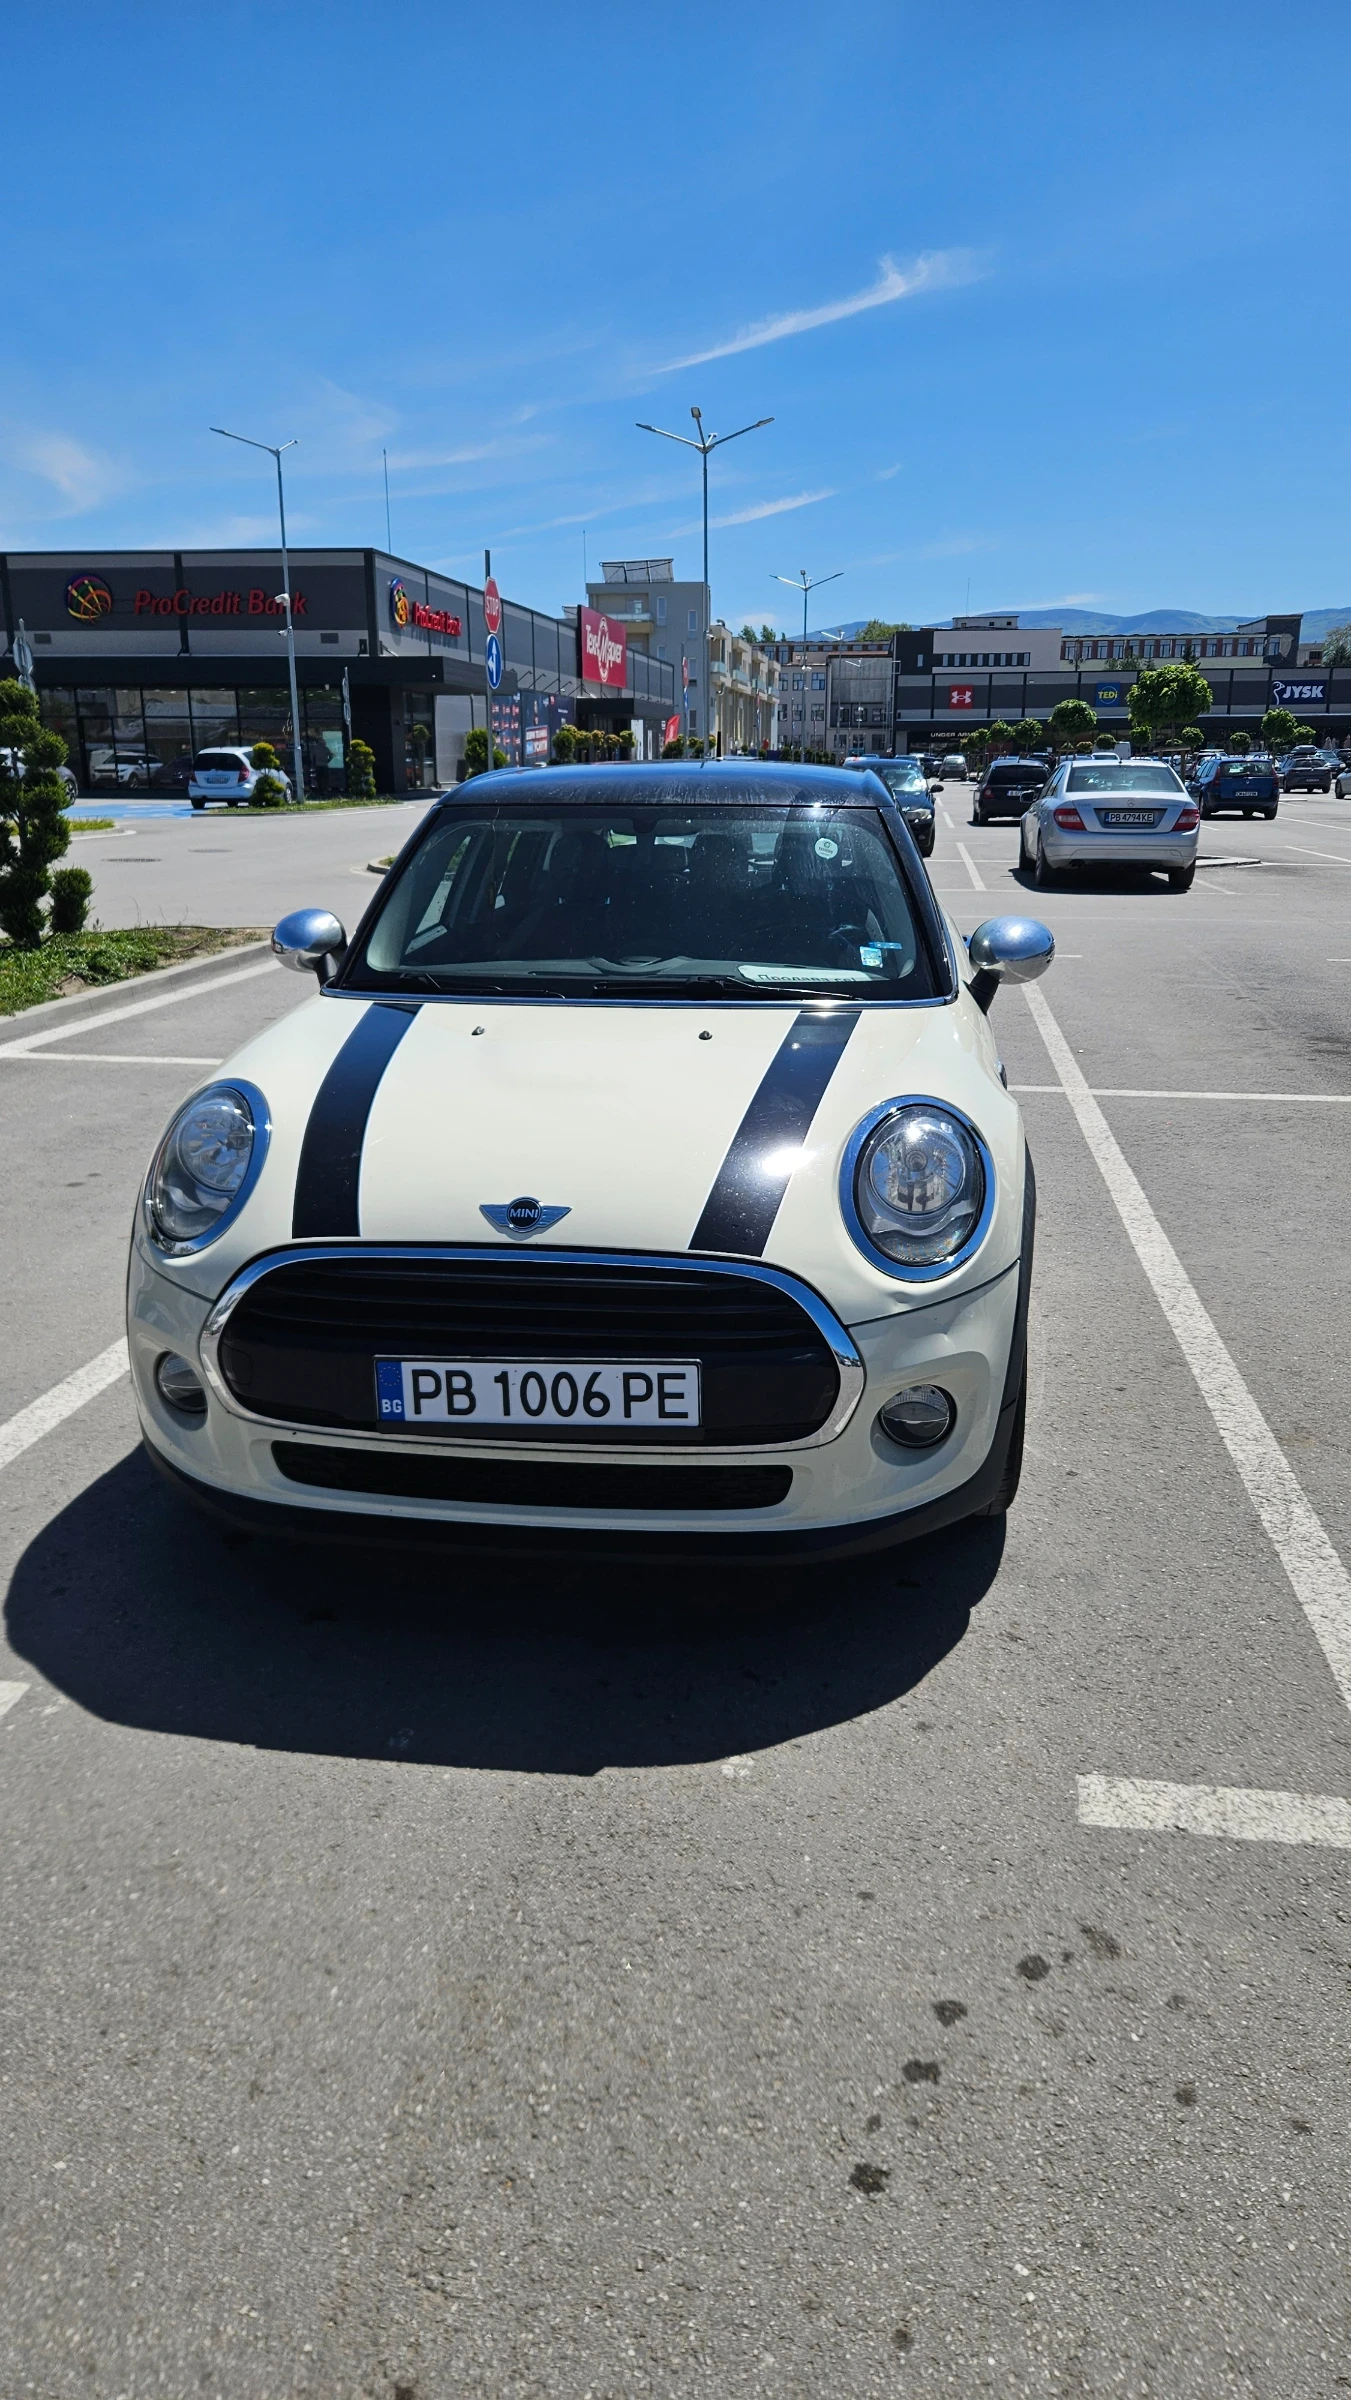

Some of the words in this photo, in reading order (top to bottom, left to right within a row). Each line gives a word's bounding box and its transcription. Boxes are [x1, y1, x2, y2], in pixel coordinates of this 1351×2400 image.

[134, 589, 241, 615] ProCredit
[486, 596, 499, 617] STOP
[1282, 685, 1324, 699] JYSK
[1110, 813, 1121, 822] PB
[1122, 813, 1141, 822] 4794
[509, 1208, 539, 1219] MINI
[411, 1368, 477, 1416] PB
[493, 1370, 611, 1419] 1006
[622, 1371, 689, 1419] PE
[381, 1398, 402, 1414] BG
